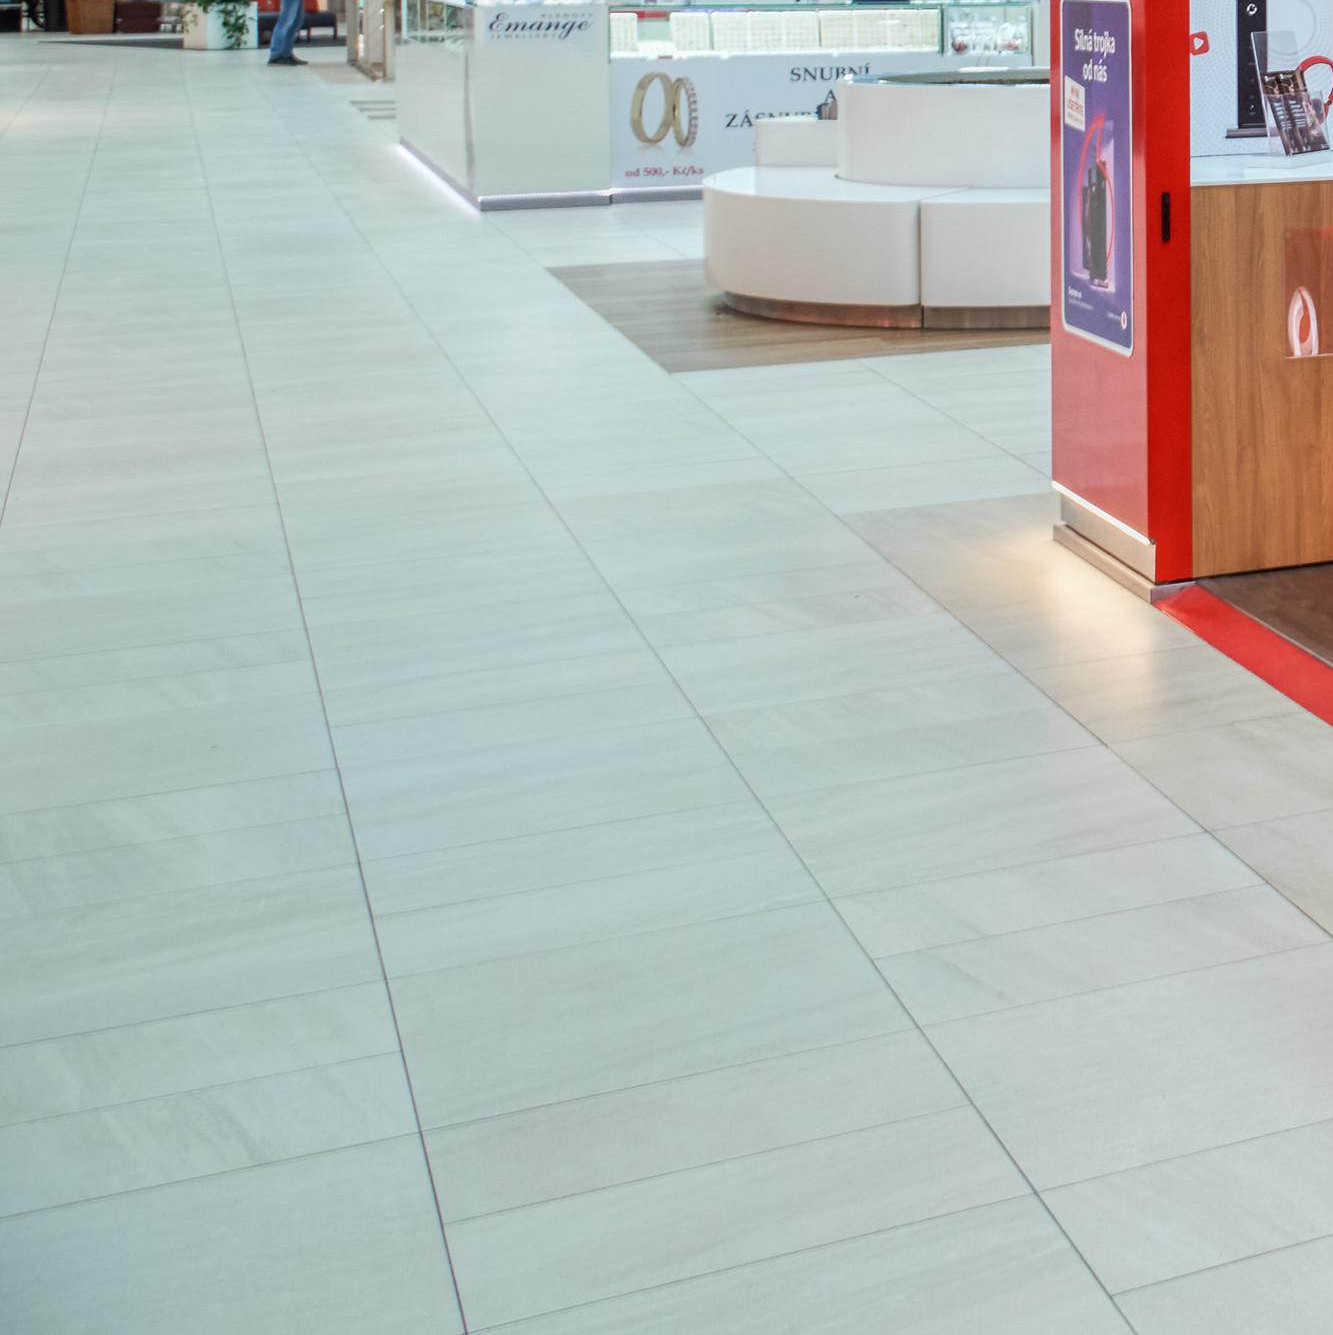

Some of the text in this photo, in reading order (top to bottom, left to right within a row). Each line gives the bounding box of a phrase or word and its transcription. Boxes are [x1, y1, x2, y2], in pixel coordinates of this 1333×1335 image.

[1075, 28, 1115, 58] Silná trojka
[1083, 59, 1107, 82] od nás
